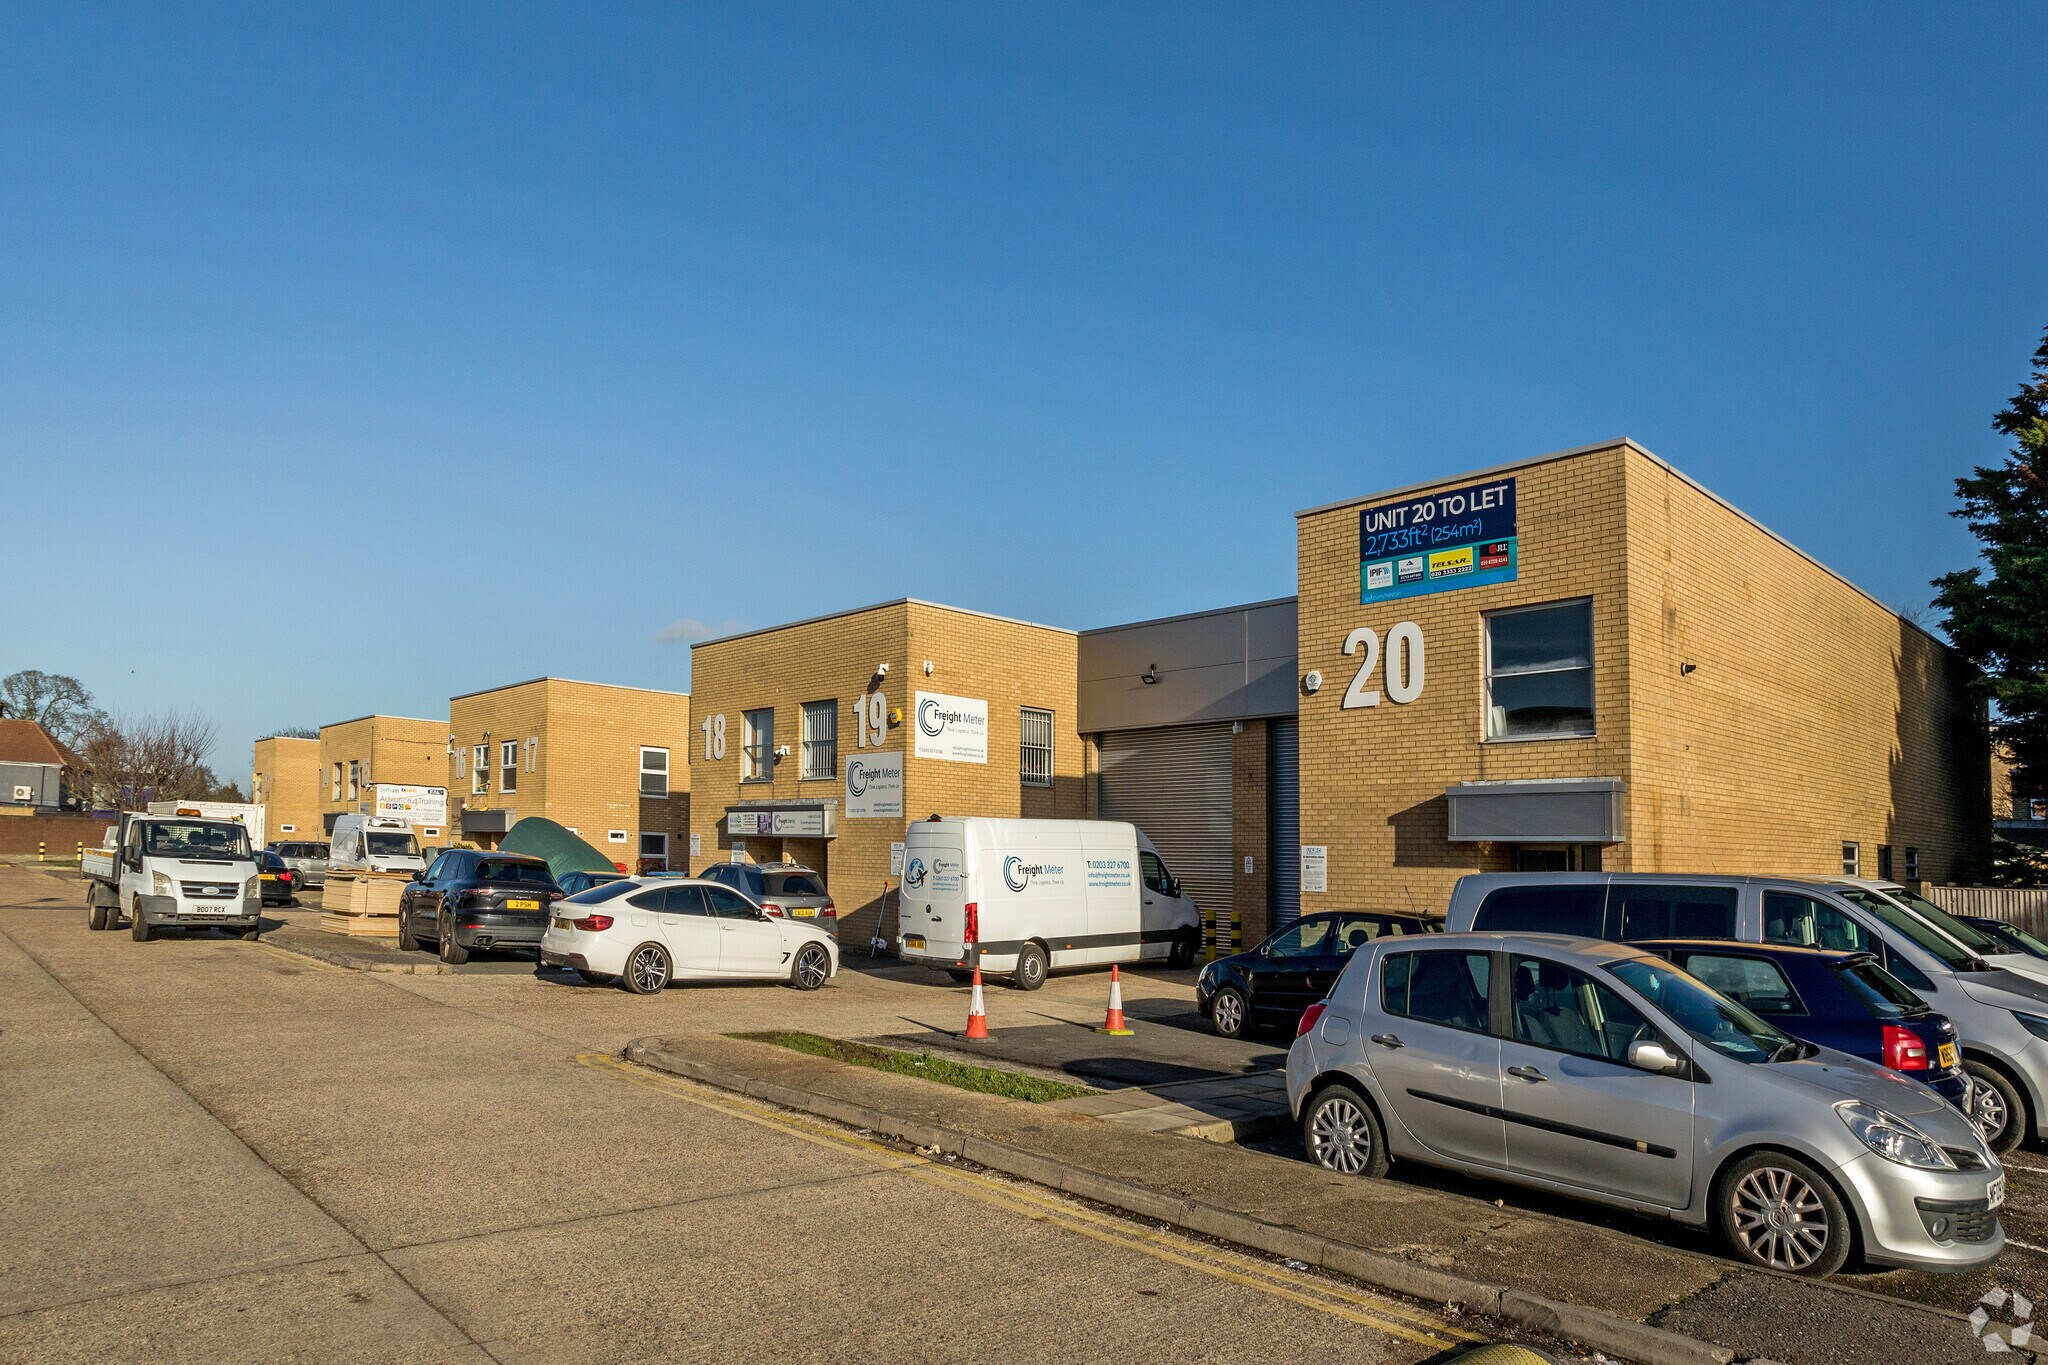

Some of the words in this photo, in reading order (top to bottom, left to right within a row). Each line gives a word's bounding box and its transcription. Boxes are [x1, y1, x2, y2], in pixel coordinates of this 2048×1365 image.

[1366, 506, 1408, 532] UNIT
[1412, 502, 1436, 524] 20
[1438, 495, 1466, 517] TO
[1470, 485, 1508, 512] LET
[1370, 567, 1382, 578] IPIF
[1432, 558, 1466, 568] TELSAR
[1344, 621, 1425, 708] 20
[853, 692, 887, 748] 19
[934, 709, 962, 724] Freight
[964, 713, 985, 725] Meter
[702, 713, 726, 760] 18
[454, 746, 466, 779] 16
[523, 736, 538, 773] 17
[860, 768, 881, 781] Freight
[882, 768, 900, 778] Meter
[1018, 864, 1043, 877] Freight
[1044, 865, 1064, 874] Meter
[1092, 861, 1106, 869] 0203
[1107, 861, 1116, 869] 327
[1117, 861, 1130, 869] 6700
